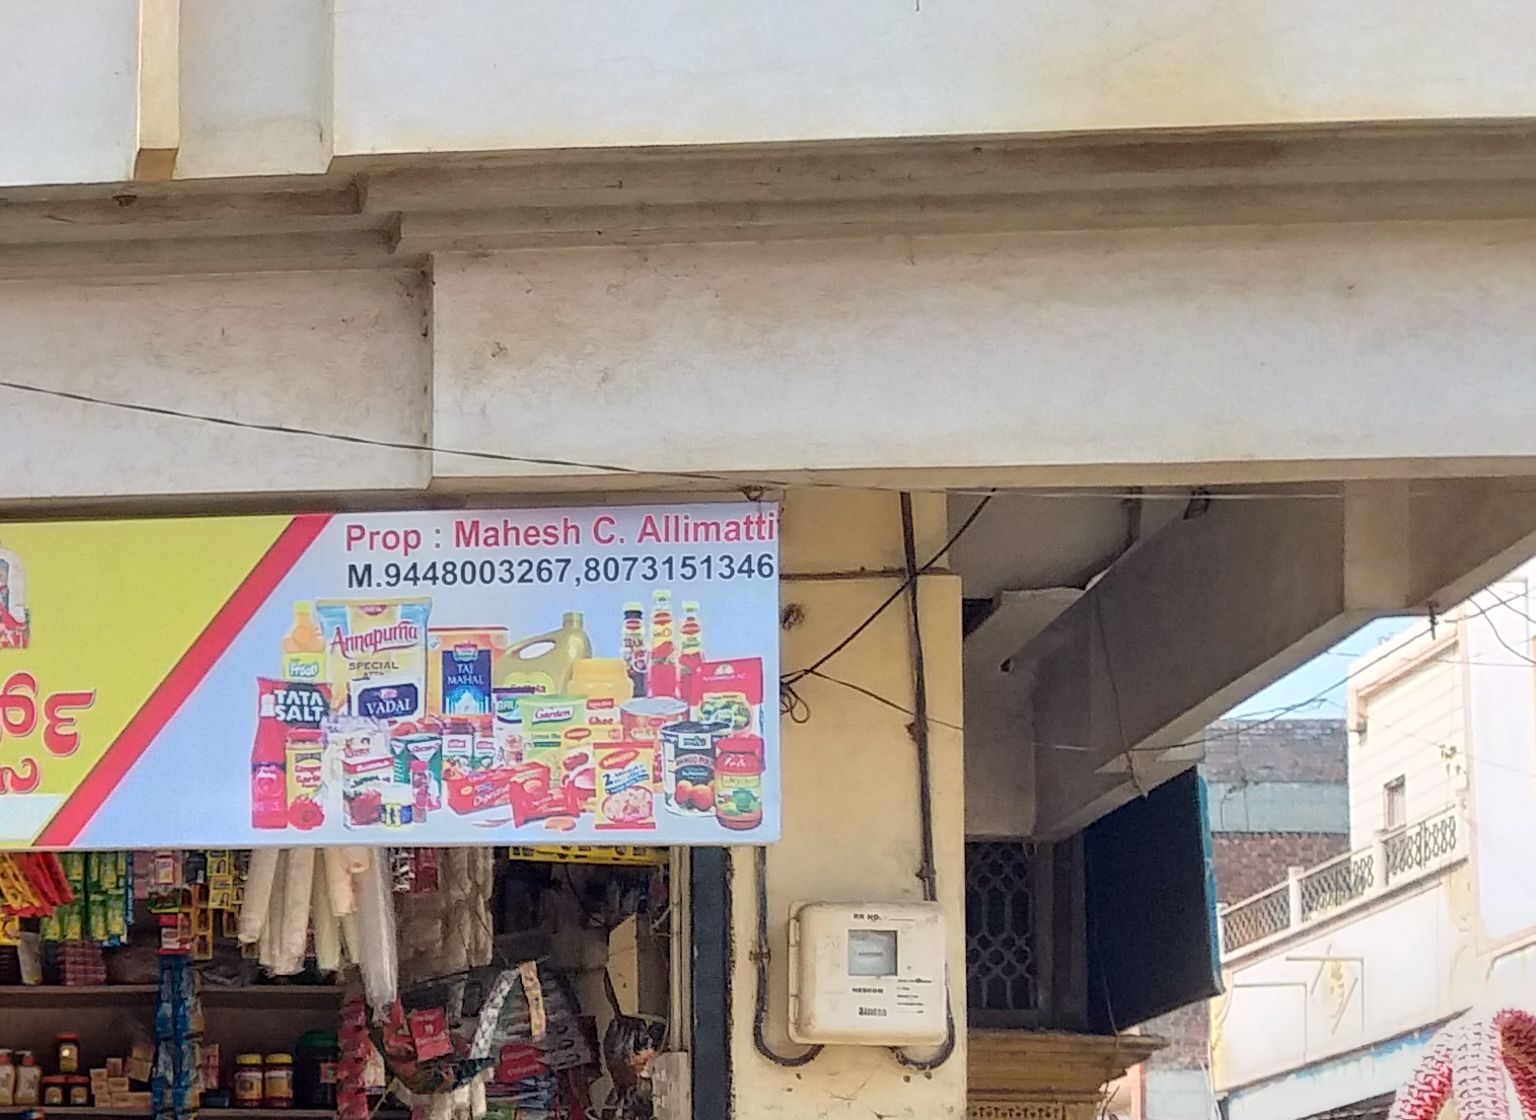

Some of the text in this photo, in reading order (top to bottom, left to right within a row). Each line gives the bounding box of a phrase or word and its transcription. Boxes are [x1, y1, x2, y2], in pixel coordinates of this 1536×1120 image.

[345, 523, 423, 557] Prop
[454, 518, 583, 549] Mahesh
[592, 516, 625, 546] C.
[638, 511, 777, 545] Allimatti
[349, 661, 399, 671] SPECIAL
[447, 674, 485, 685] MAHAL
[273, 689, 324, 706] TATA
[274, 705, 325, 722] SALT
